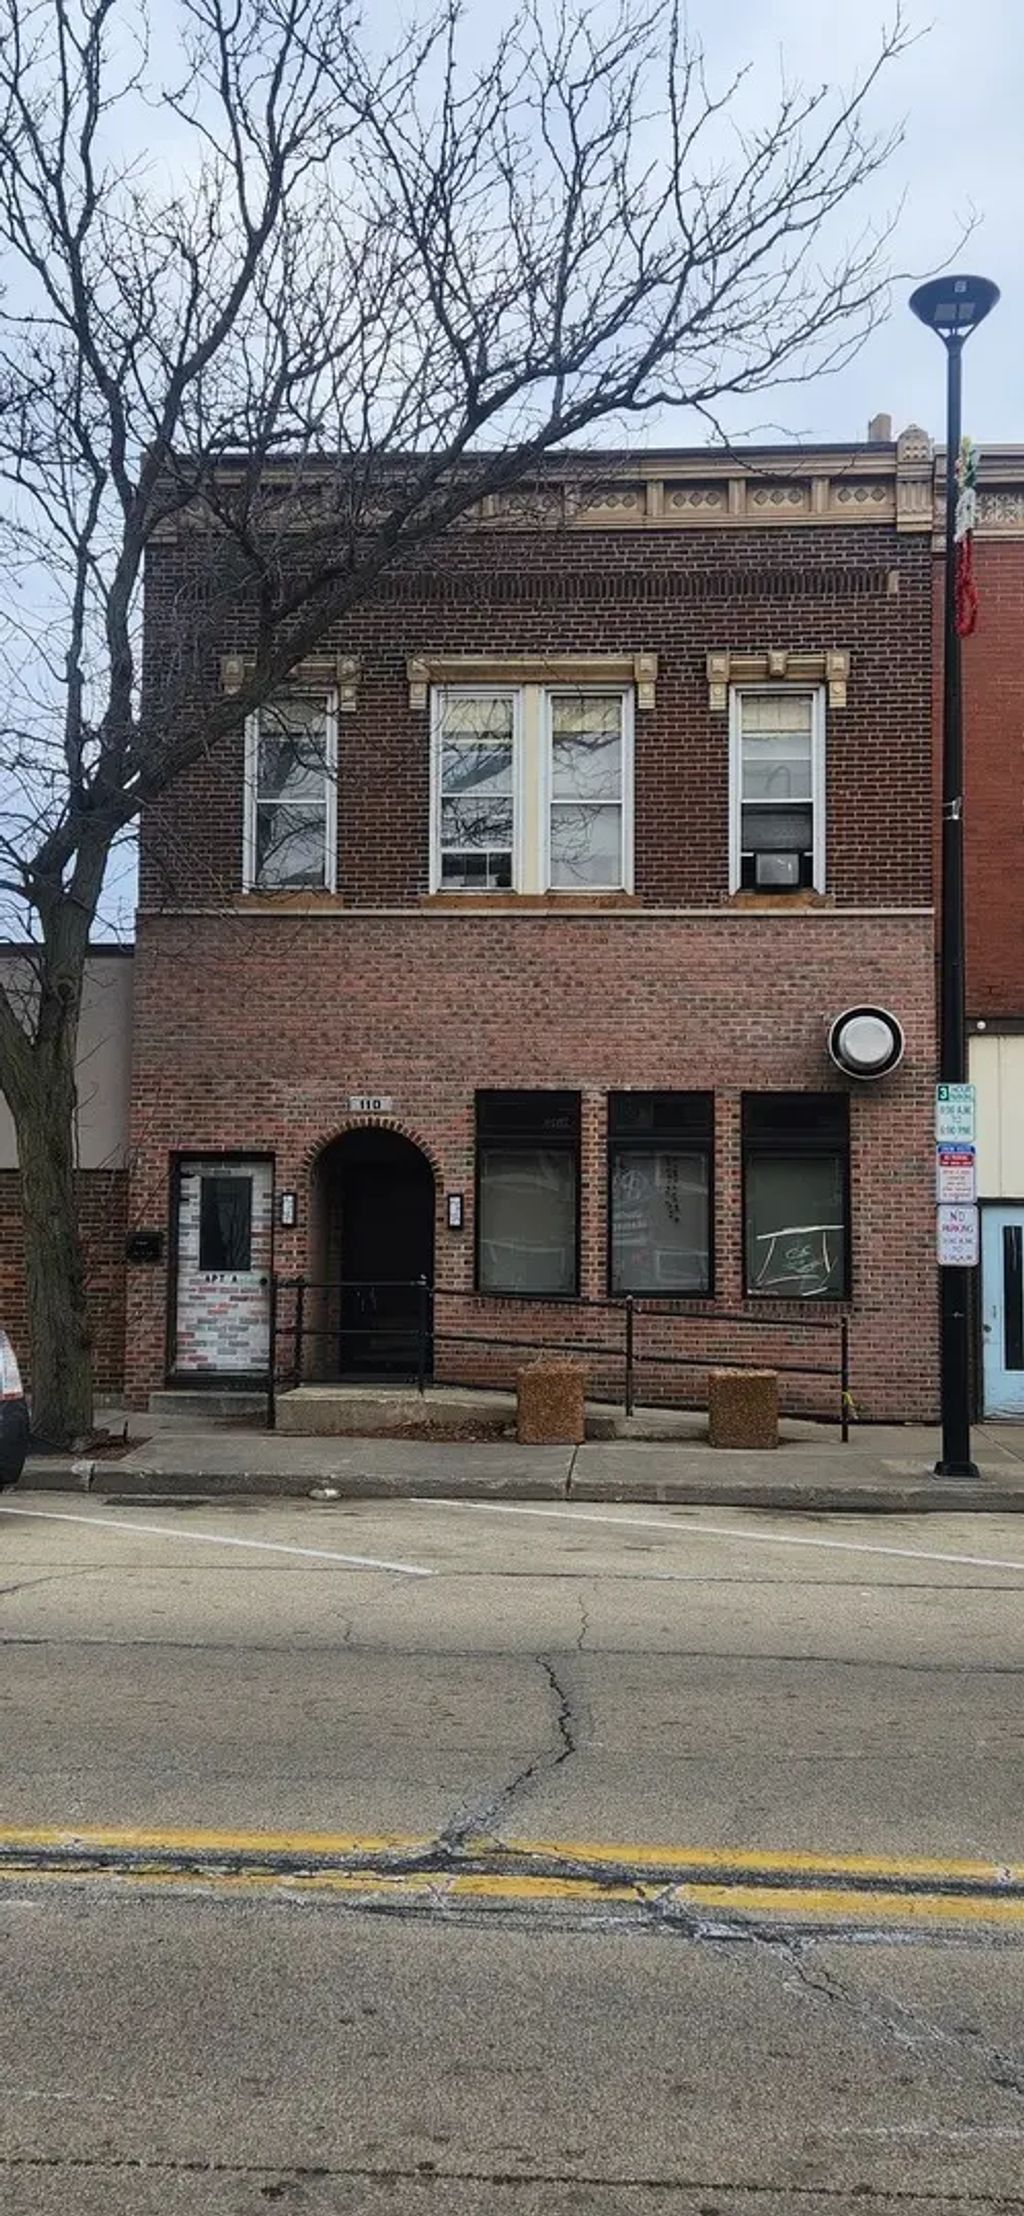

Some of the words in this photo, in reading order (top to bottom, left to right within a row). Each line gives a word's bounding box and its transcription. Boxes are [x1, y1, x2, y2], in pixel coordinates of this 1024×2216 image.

[940, 1087, 948, 1100] 3
[361, 1100, 381, 1110] 110
[950, 1210, 965, 1222] NO
[942, 1224, 974, 1233] PARKING
[205, 1274, 225, 1283] APT
[231, 1275, 238, 1283] A
